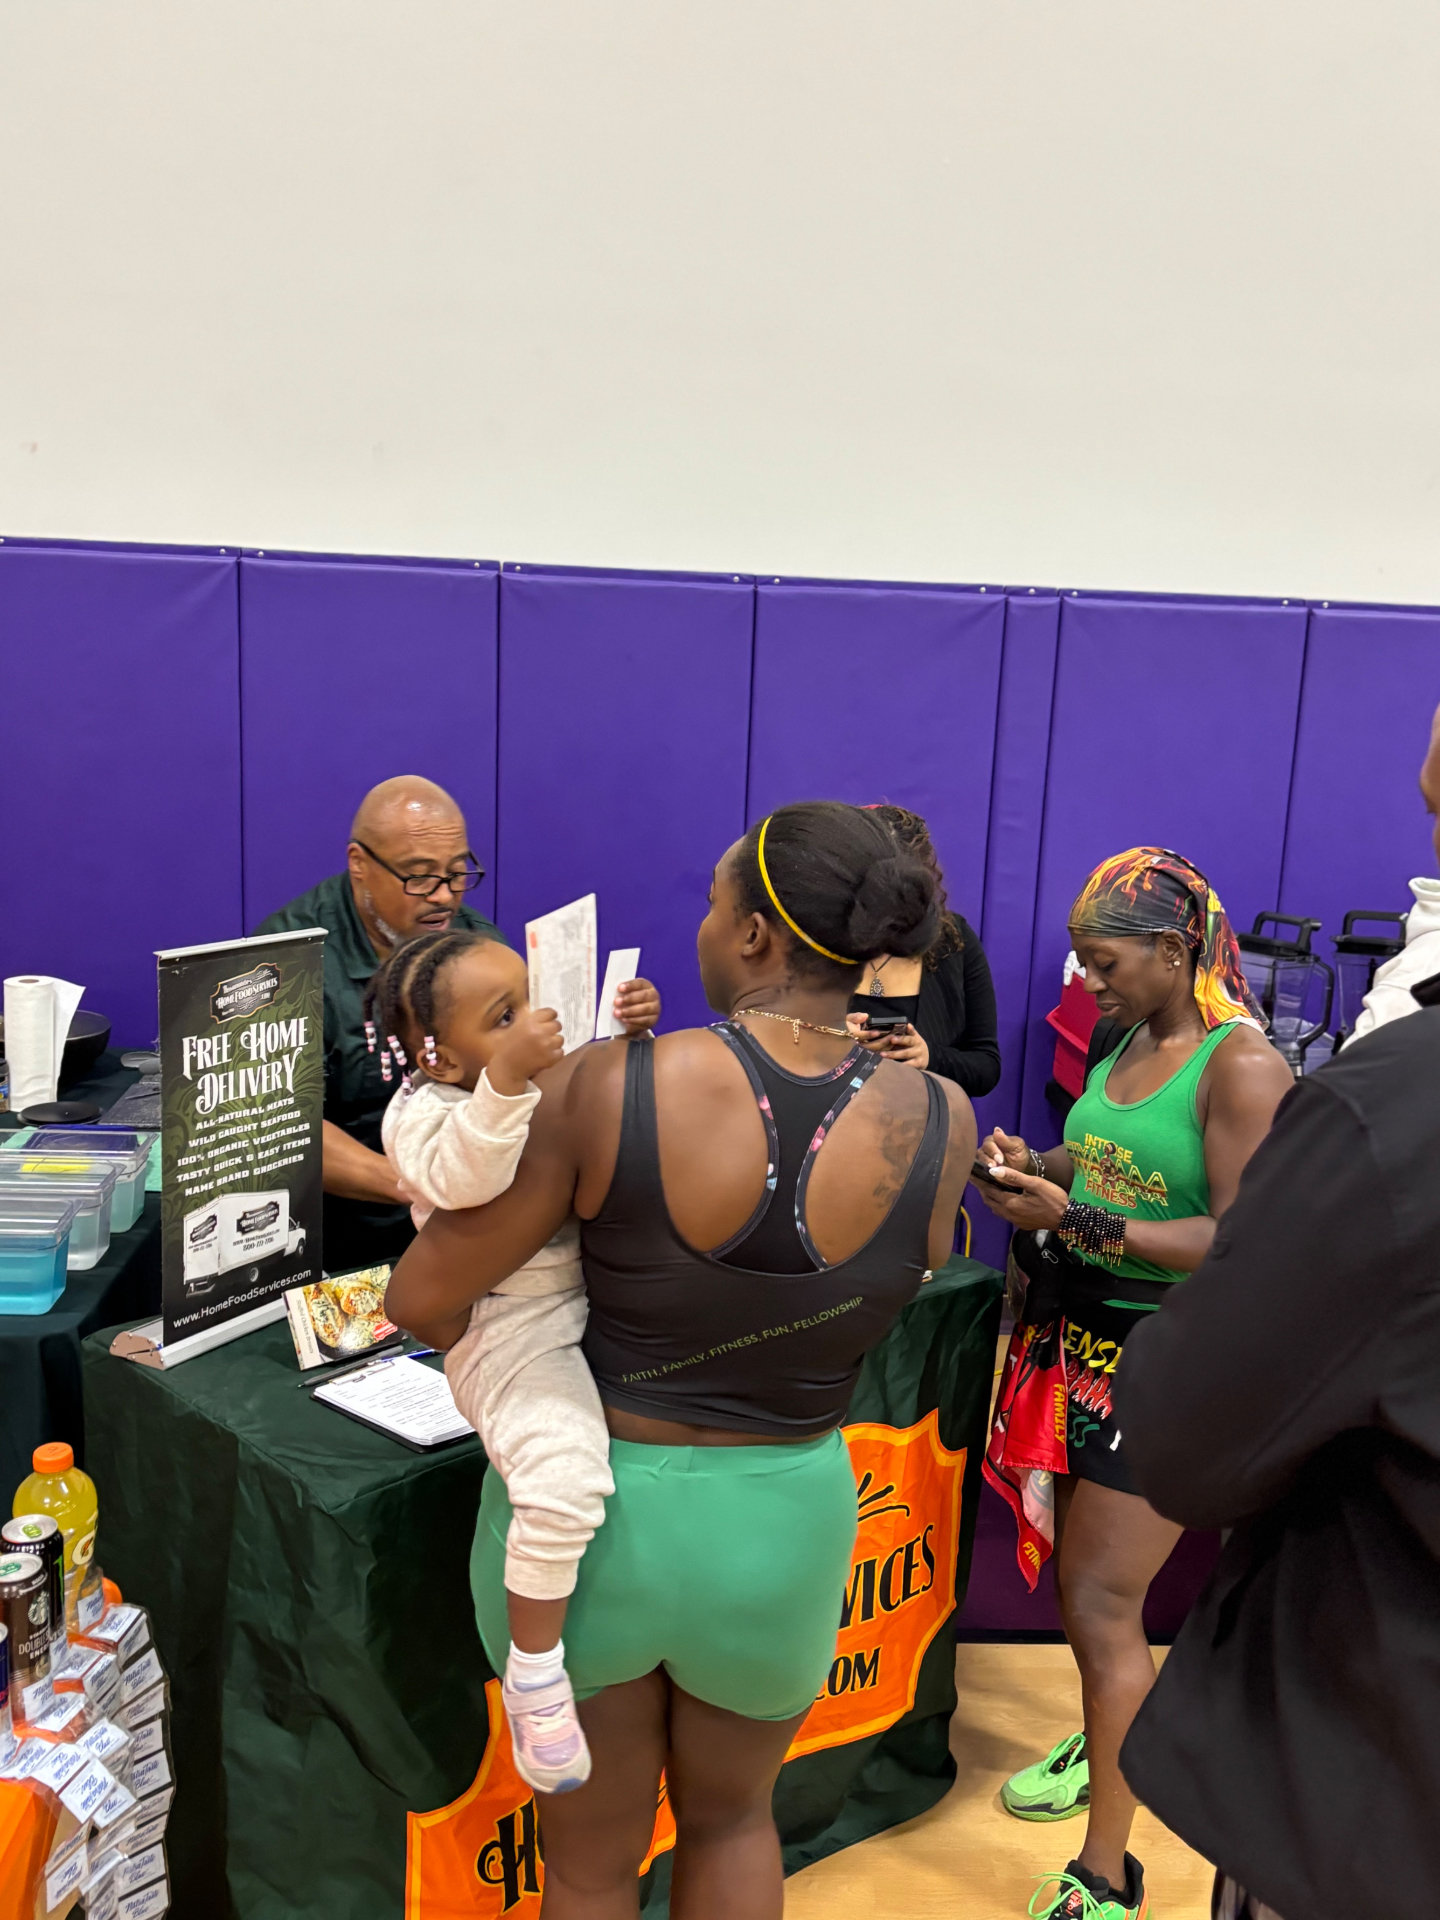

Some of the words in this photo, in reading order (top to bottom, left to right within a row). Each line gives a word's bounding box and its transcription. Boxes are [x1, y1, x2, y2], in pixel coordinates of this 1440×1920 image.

[182, 1032, 233, 1081] FREE
[240, 1016, 309, 1063] HOME
[195, 1047, 303, 1115] DELIVERY
[188, 1135, 216, 1148] WILD
[218, 1122, 259, 1139] CAUGHT
[260, 1110, 301, 1128] SEAFOOD
[195, 1106, 265, 1130] ALL-NATURAL
[266, 1097, 295, 1112] MEATS
[176, 1168, 211, 1182] TASTY
[213, 1156, 243, 1172] QUICK
[258, 1145, 281, 1160] EASY
[283, 1137, 311, 1151] ITEMS
[177, 1154, 205, 1167] 100%
[207, 1139, 249, 1159] ORGANIC
[252, 1123, 311, 1146] VEGETABLES
[185, 1181, 215, 1197] NAME
[216, 1169, 250, 1187] BRAND
[253, 1153, 304, 1175] GROCERIES
[1085, 1179, 1137, 1209] FITNESS
[173, 1268, 312, 1328] www.HomeFoodServices.com
[622, 1368, 662, 1384] FAITH,
[662, 1352, 709, 1374] FAMILY,
[709, 1333, 762, 1357] FITNESS,
[762, 1324, 793, 1340] FUN,
[793, 1296, 863, 1331] FELLOWSHIP
[1053, 1383, 1067, 1444] FAMILY
[838, 1524, 935, 1630] VICES
[1022, 1541, 1041, 1571] FITN
[815, 1646, 882, 1701] OM
